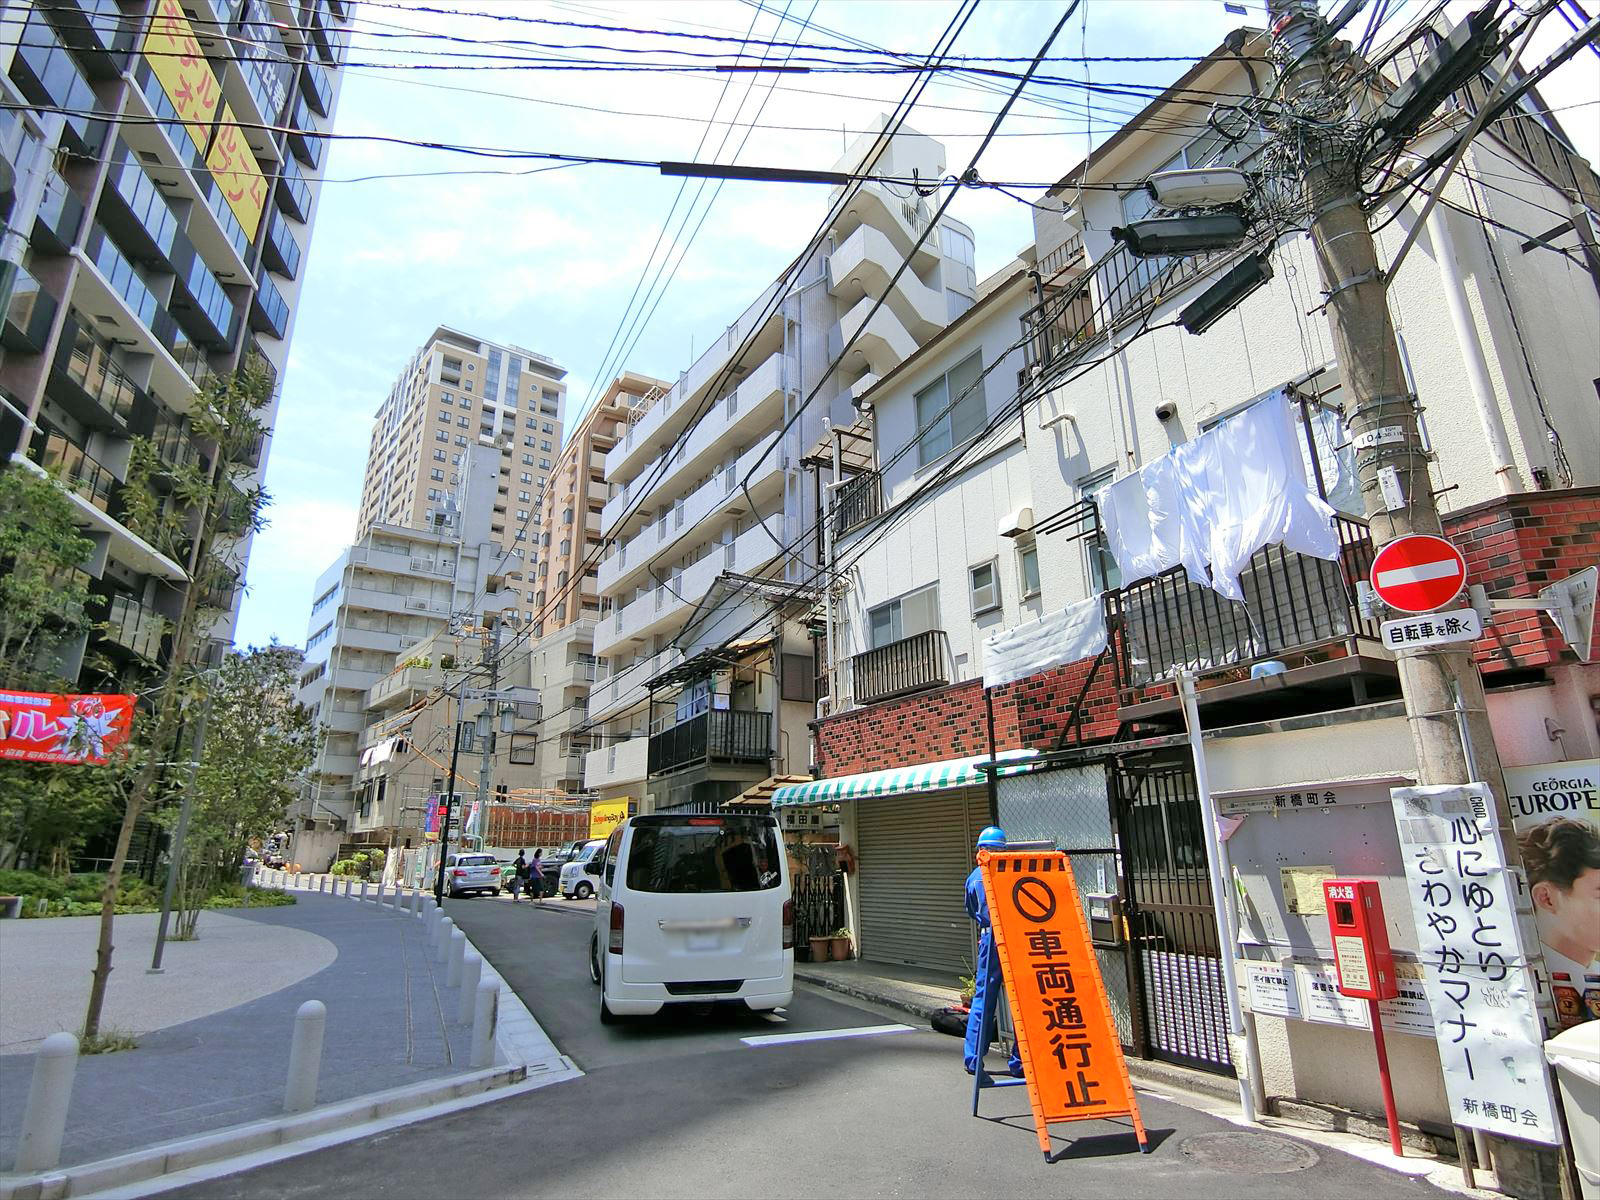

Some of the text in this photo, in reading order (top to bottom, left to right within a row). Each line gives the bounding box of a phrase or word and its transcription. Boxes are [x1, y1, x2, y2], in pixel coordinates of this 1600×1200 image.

[1389, 619, 1472, 643] 自転車を除く
[1274, 791, 1337, 808] 新橋町会
[1327, 886, 1354, 899] 消火器
[1451, 816, 1507, 982] 心にゆとり
[1415, 847, 1477, 1081] さわやかマナー
[1024, 928, 1106, 1109] 車両通行止
[1462, 1097, 1539, 1128] 新橋町会
